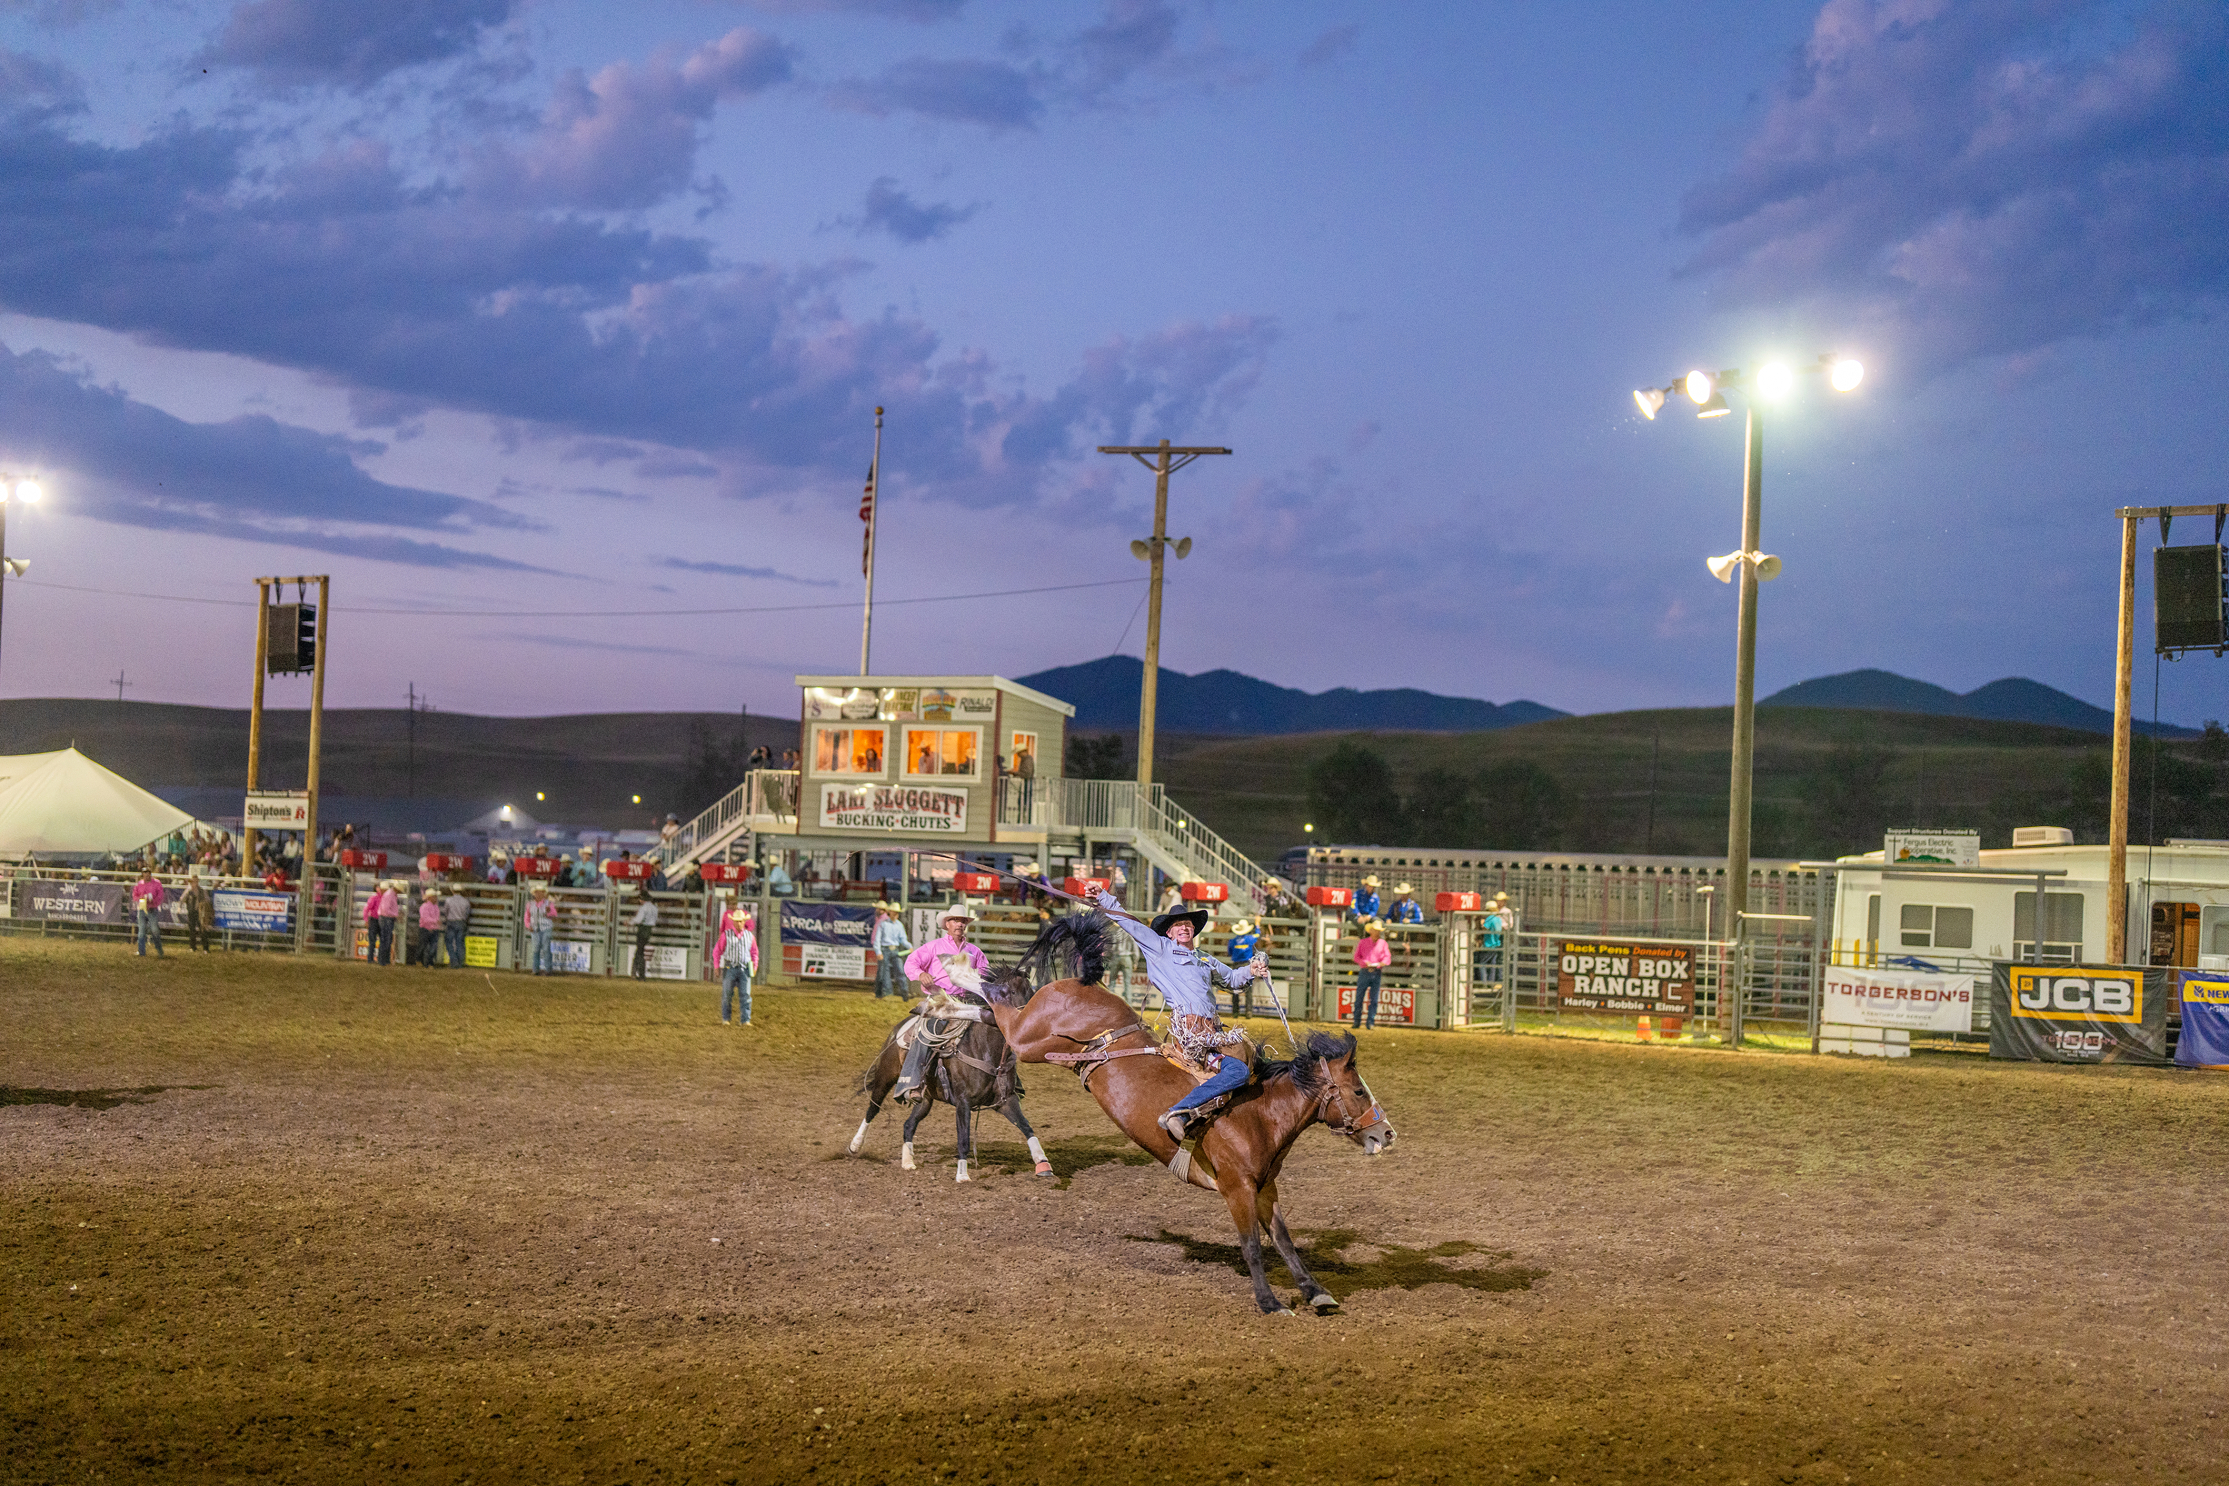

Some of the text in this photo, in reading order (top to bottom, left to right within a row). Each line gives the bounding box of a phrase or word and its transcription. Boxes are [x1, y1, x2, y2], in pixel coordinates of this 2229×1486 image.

[873, 788, 965, 818] SLUGGETT
[247, 804, 292, 821] Shipton's
[836, 814, 951, 829] BUCKING CHUTES
[1904, 838, 1926, 847] Fergus
[1928, 838, 1954, 846] Electric
[362, 853, 378, 864] 2W
[448, 856, 464, 868] 2W
[536, 861, 551, 872] 2W
[628, 864, 643, 876] 2W
[723, 866, 738, 879] 2W
[976, 876, 992, 889] 2W
[1206, 885, 1221, 899] 2W
[1331, 890, 1345, 904] 2W
[33, 897, 105, 914] WESTERN
[1461, 895, 1474, 909] 2W
[790, 916, 823, 932] PRCA
[1565, 943, 1687, 959] Back Pens Donated by
[1562, 955, 1689, 979] OPEN BOX
[1574, 975, 1660, 998] RANCH
[1828, 982, 1970, 1003] TORGERSON'S
[1341, 990, 1412, 1008] SIONS
[2020, 978, 2131, 1012] JCB
[1564, 997, 1686, 1013] Harley Bobbie Elmer
[2055, 1030, 2104, 1050] 100
